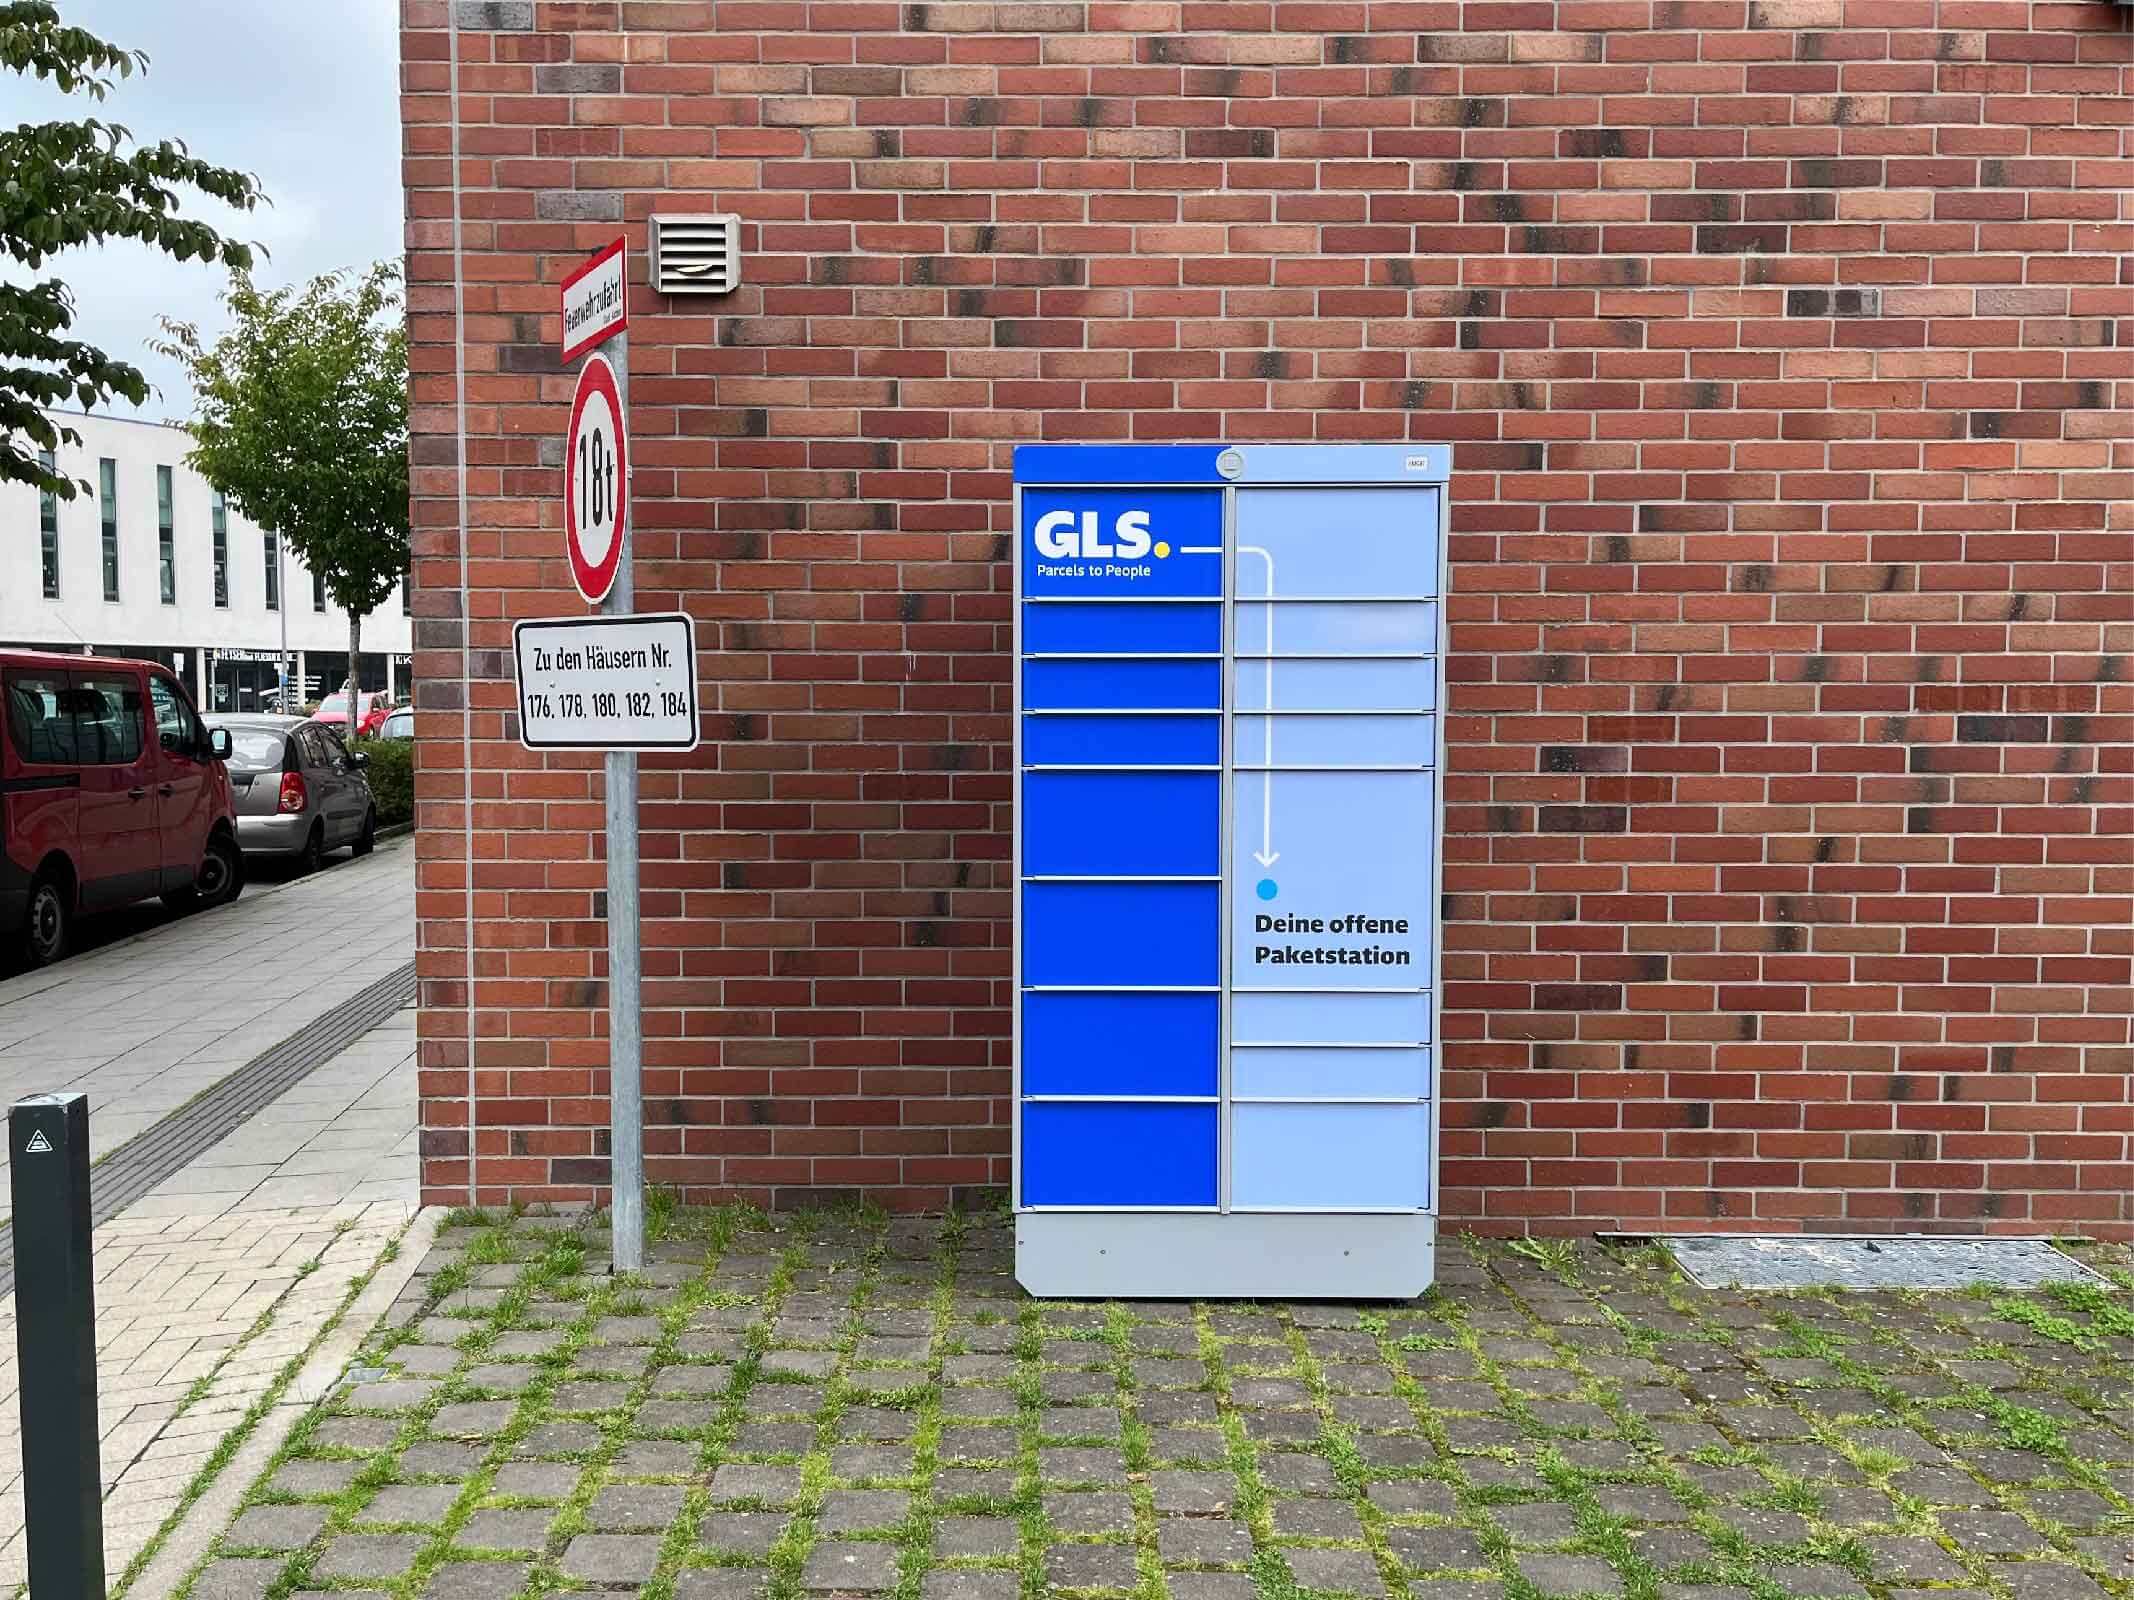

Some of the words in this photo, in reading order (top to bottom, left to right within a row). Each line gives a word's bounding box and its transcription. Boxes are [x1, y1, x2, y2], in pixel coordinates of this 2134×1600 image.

[565, 273, 621, 334] Feuerwehrzufahrt
[1037, 563, 1085, 577] Parcels
[1089, 565, 1103, 577] to
[1105, 563, 1151, 581] People
[534, 647, 550, 671] Zu
[556, 646, 582, 671] den
[586, 644, 647, 670] Häusern
[651, 643, 672, 668] Nr.
[625, 692, 655, 718] 182,
[660, 691, 687, 717] 184
[1255, 912, 1324, 933] Deine
[1329, 914, 1409, 934] offene
[1255, 945, 1411, 965] Paketstation
